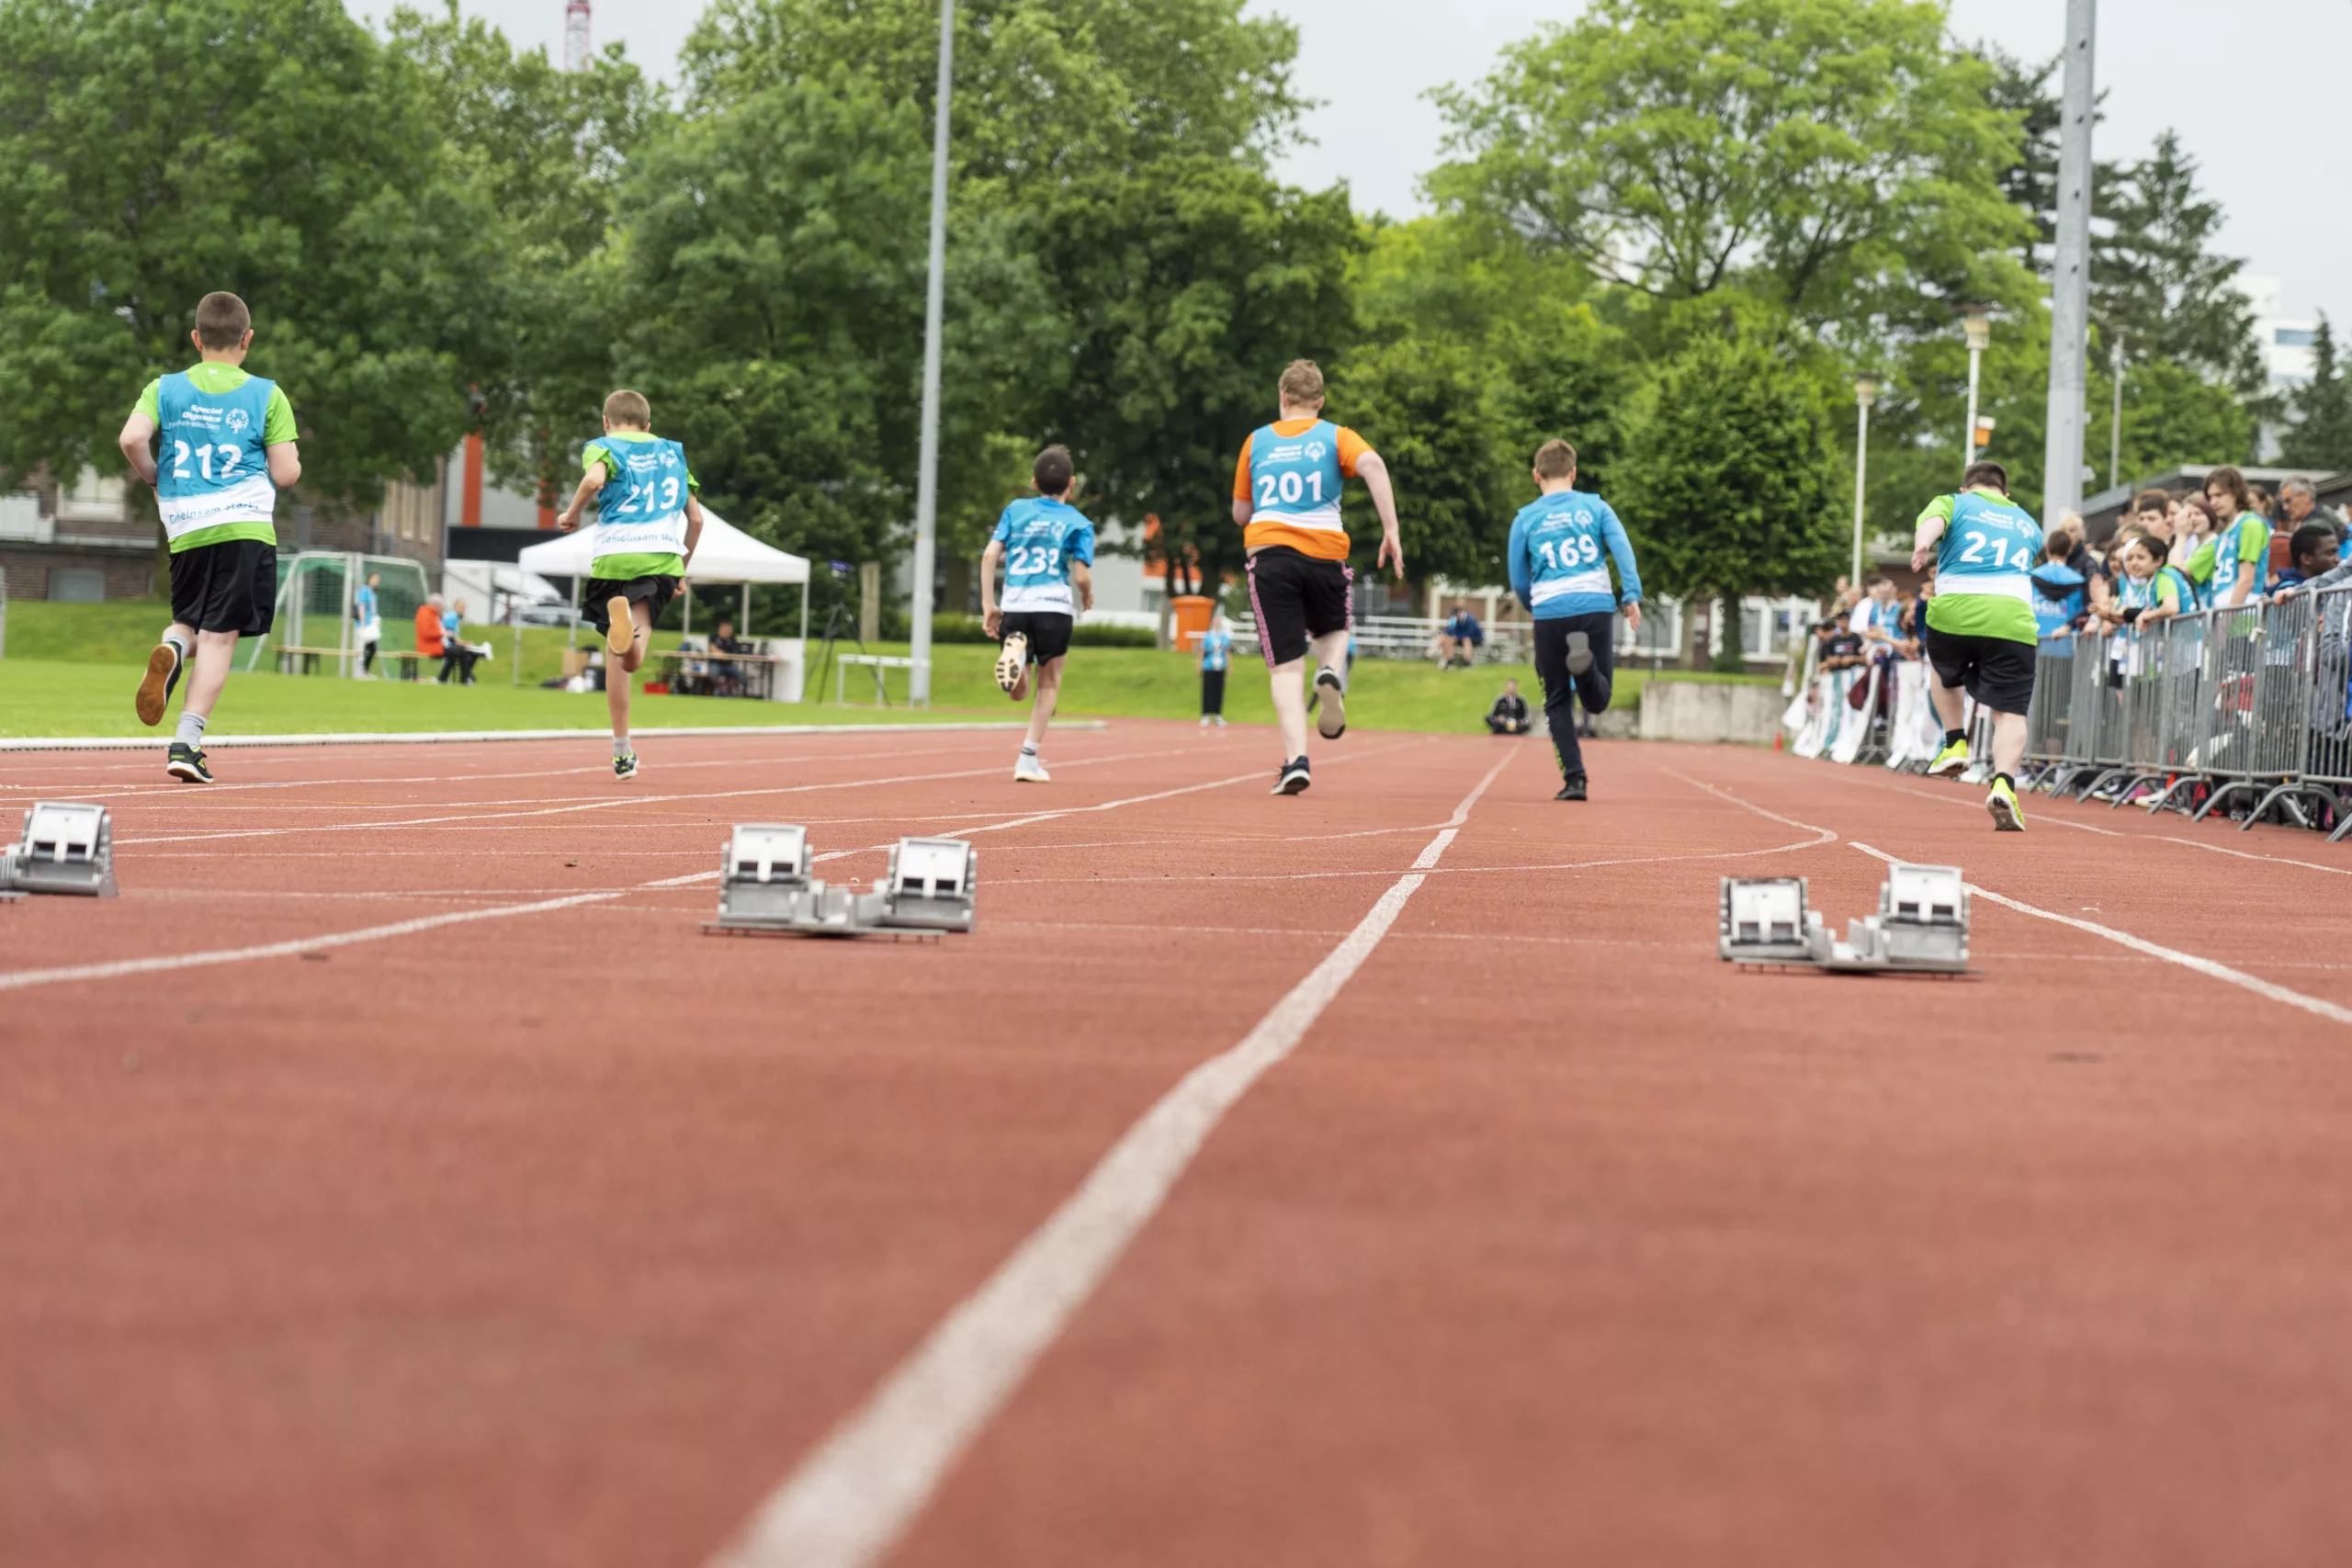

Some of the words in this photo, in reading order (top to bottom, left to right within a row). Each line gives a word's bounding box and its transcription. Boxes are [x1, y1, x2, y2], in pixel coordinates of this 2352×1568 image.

[173, 439, 246, 479] 212
[616, 477, 679, 513] 213
[1258, 470, 1322, 507] 201
[1540, 534, 1599, 569] 169
[1960, 531, 2030, 571] 214
